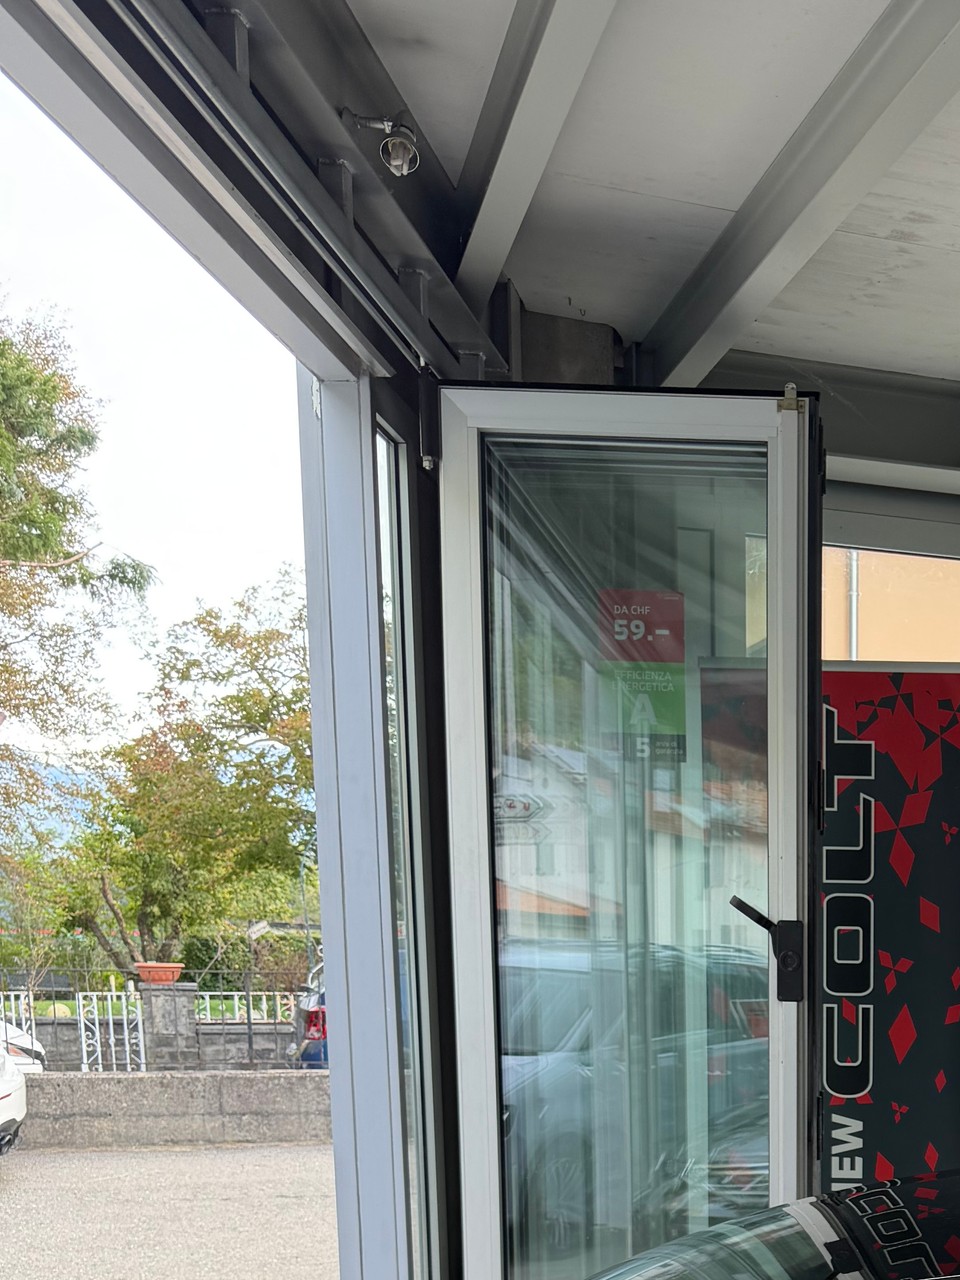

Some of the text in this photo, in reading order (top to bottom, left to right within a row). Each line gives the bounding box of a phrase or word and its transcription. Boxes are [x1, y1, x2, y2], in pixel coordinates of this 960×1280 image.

[613, 605, 651, 615] DA CHF
[630, 693, 657, 725] A
[636, 737, 651, 758] 5
[822, 703, 875, 1099] COLT
